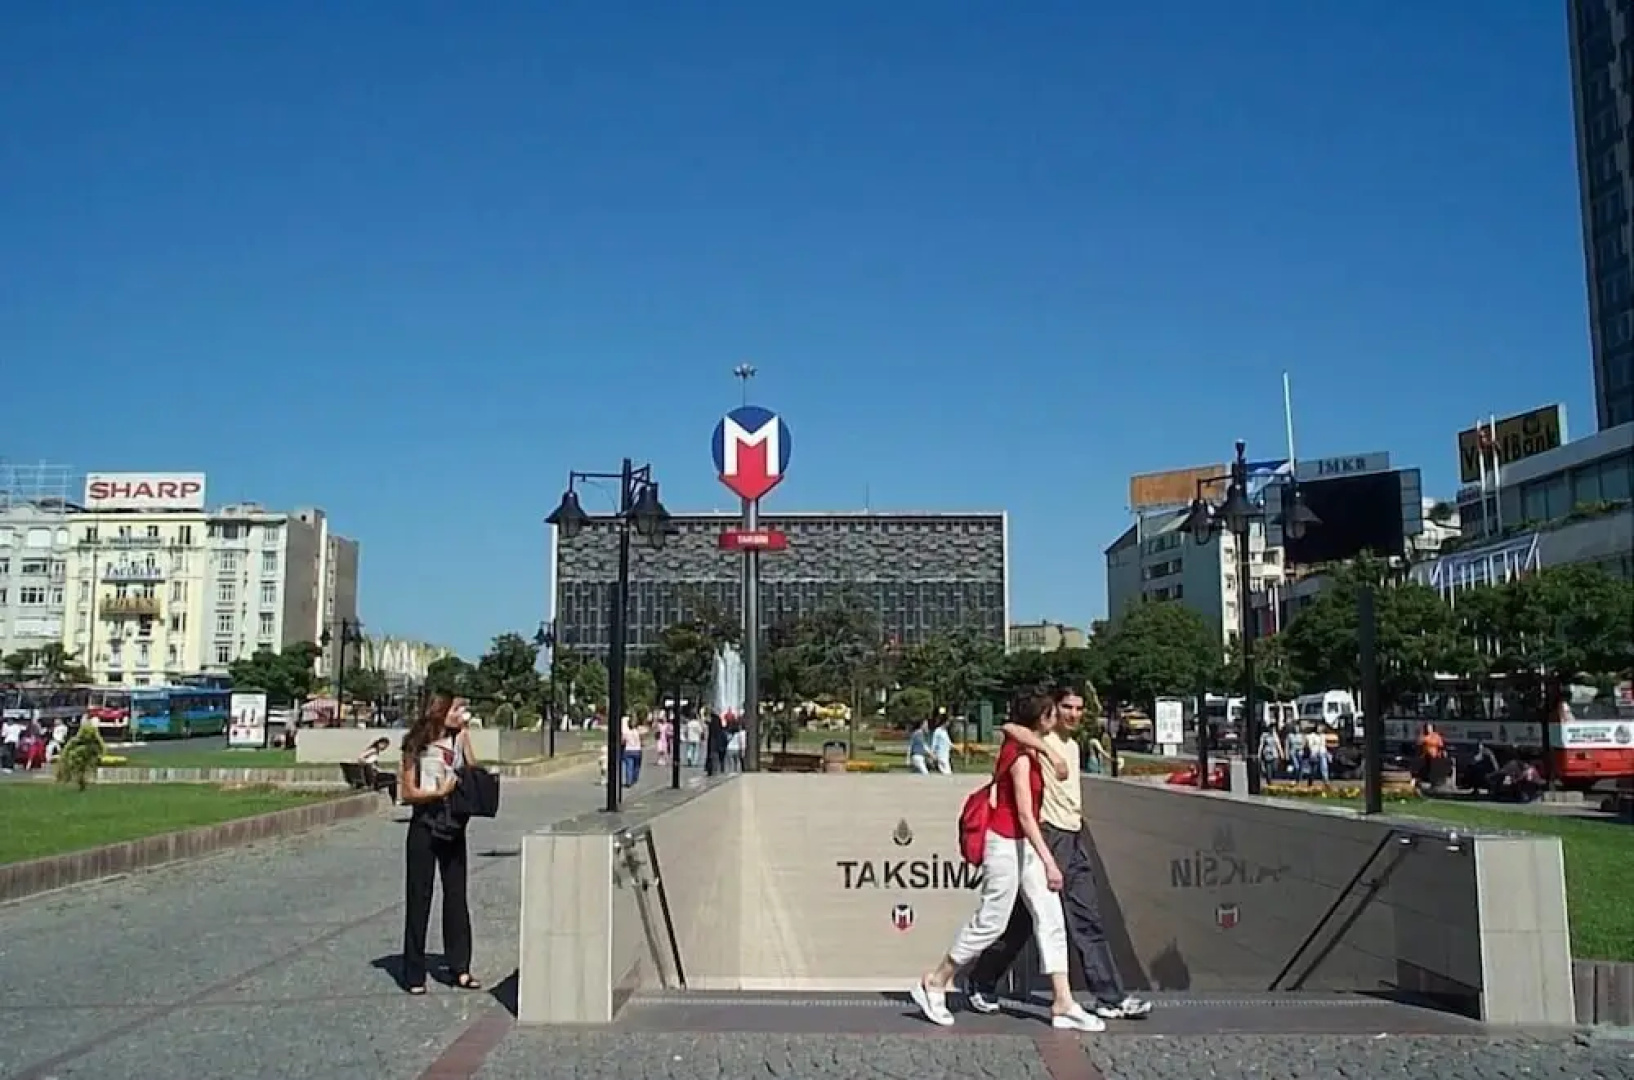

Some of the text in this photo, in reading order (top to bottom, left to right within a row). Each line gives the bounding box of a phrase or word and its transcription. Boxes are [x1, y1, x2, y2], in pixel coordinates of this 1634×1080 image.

[723, 414, 779, 476] M
[89, 481, 201, 499] SHARP
[836, 853, 971, 889] TAKSİM
